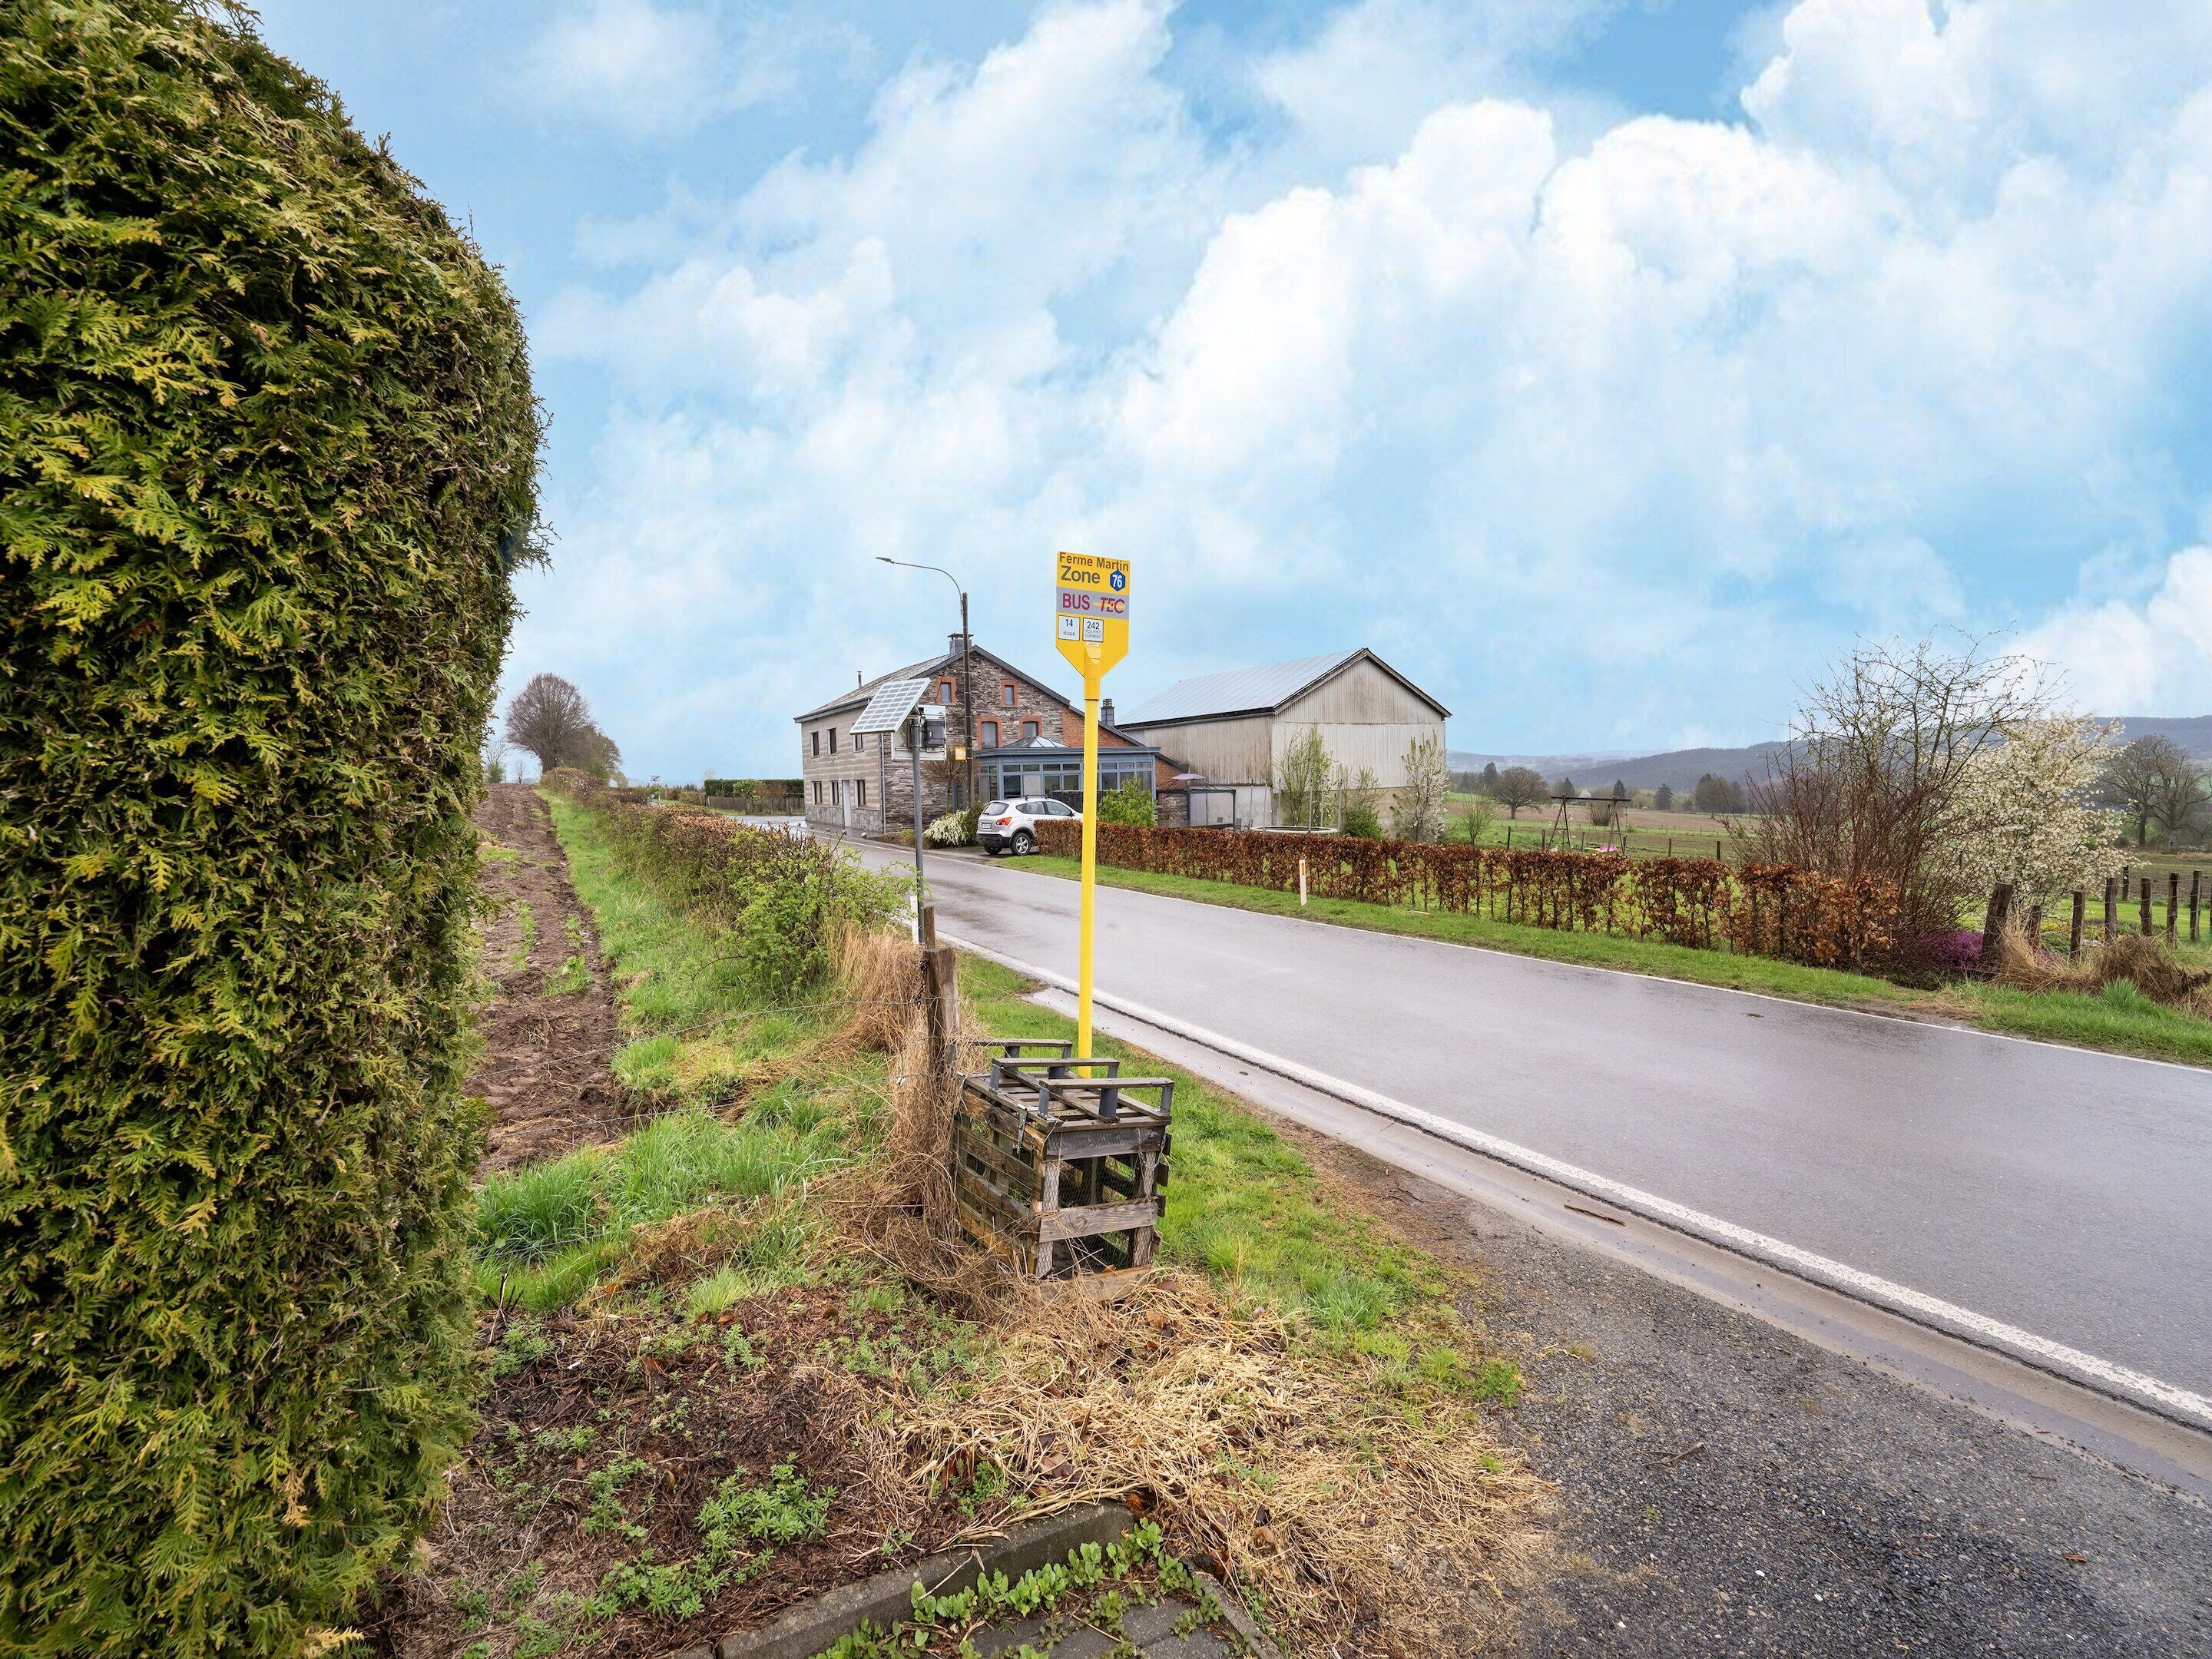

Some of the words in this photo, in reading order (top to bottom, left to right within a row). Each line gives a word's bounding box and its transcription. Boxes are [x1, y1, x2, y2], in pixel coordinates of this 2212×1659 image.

[1059, 552, 1093, 567] Ferme
[1097, 557, 1129, 571] Martin
[1061, 565, 1101, 584] Zone
[1112, 574, 1123, 588] 76
[1062, 593, 1091, 611] BUS
[1100, 597, 1125, 614] TEC
[1065, 619, 1073, 628] 14
[1087, 621, 1100, 630] 242
